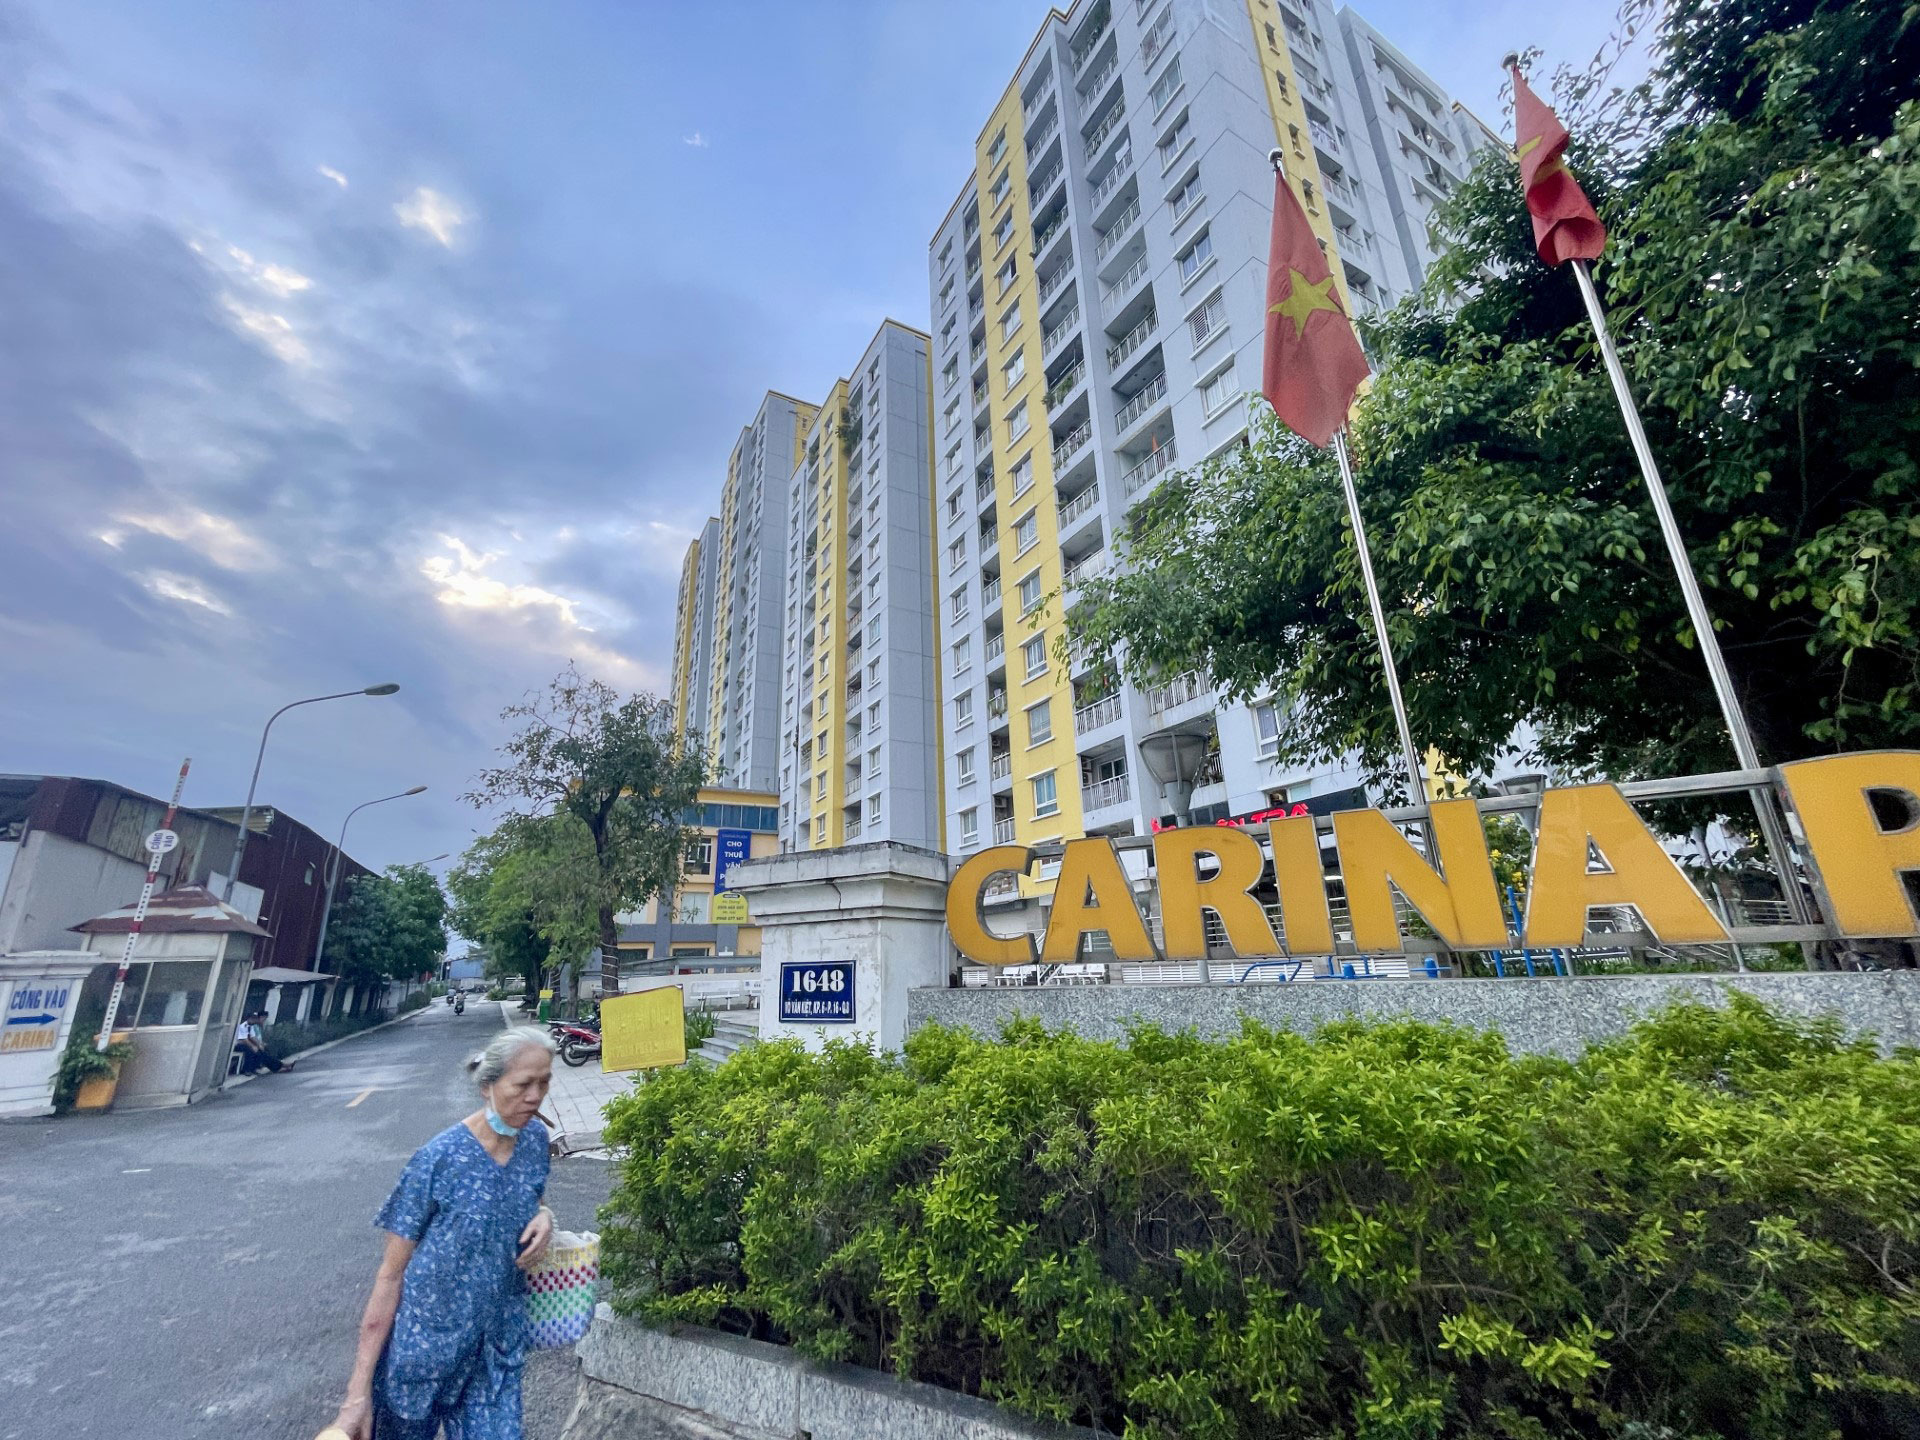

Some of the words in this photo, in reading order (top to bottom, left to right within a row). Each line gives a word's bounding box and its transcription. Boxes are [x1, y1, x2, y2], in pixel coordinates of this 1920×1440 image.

[724, 850, 744, 859] THUÊ
[726, 840, 743, 848] CHO
[945, 782, 1733, 967] CARINA
[791, 969, 845, 993] 1648
[44, 984, 68, 1009] VÀO
[1, 1029, 56, 1050] CARINA
